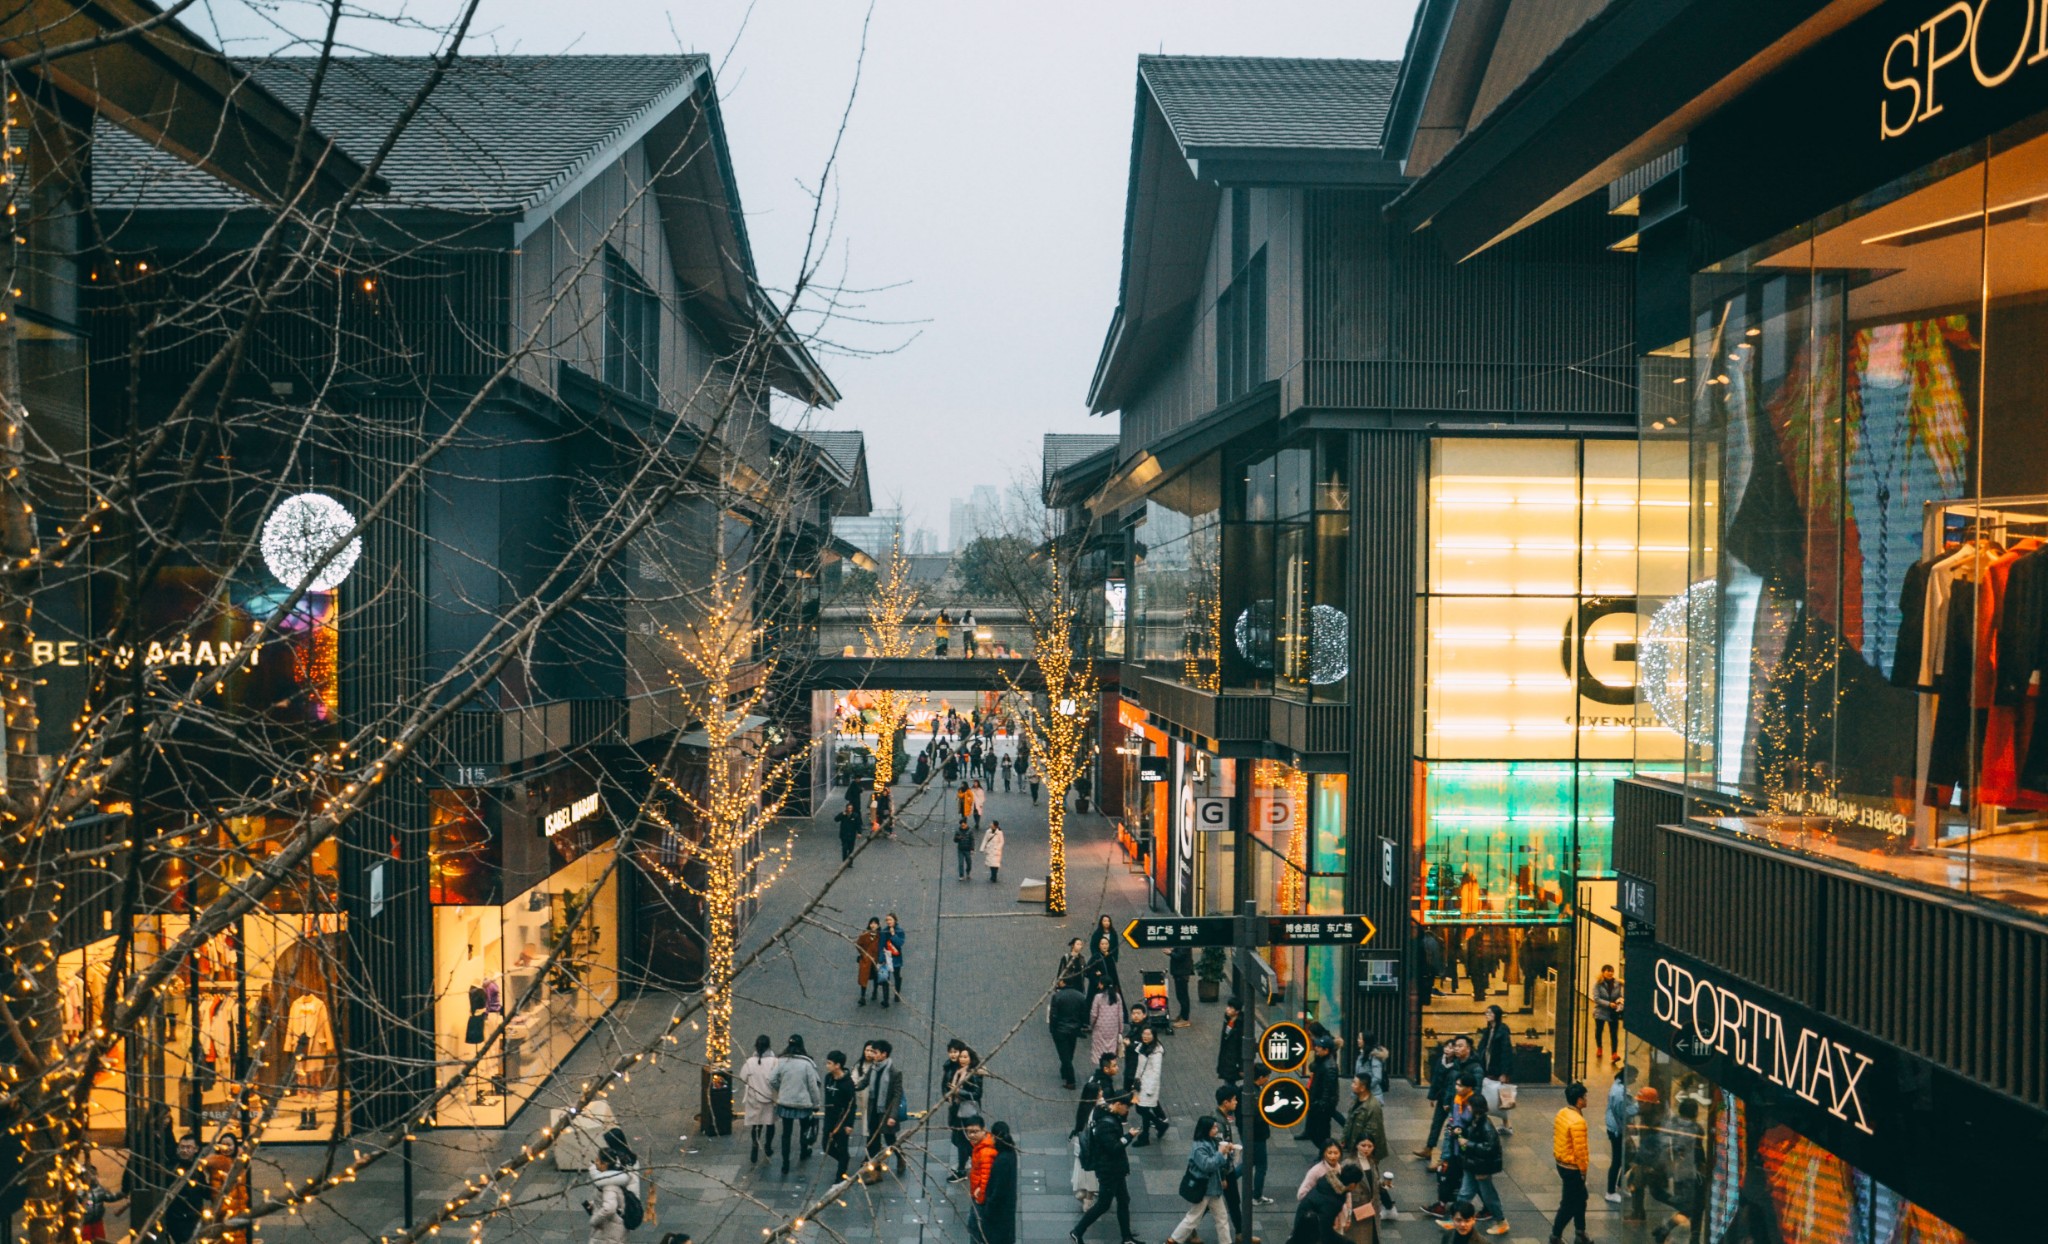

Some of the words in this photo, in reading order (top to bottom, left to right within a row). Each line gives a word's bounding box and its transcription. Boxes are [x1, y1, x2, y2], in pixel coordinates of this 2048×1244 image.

[544, 806, 572, 837] ISABEL
[571, 792, 600, 823] MARANT
[1201, 802, 1224, 824] G
[1385, 848, 1390, 877] G
[1147, 925, 1174, 935] 西广场
[1180, 924, 1199, 935] 地铁
[1326, 923, 1353, 933] 东广场
[1653, 958, 1874, 1135] SPORTMAX
